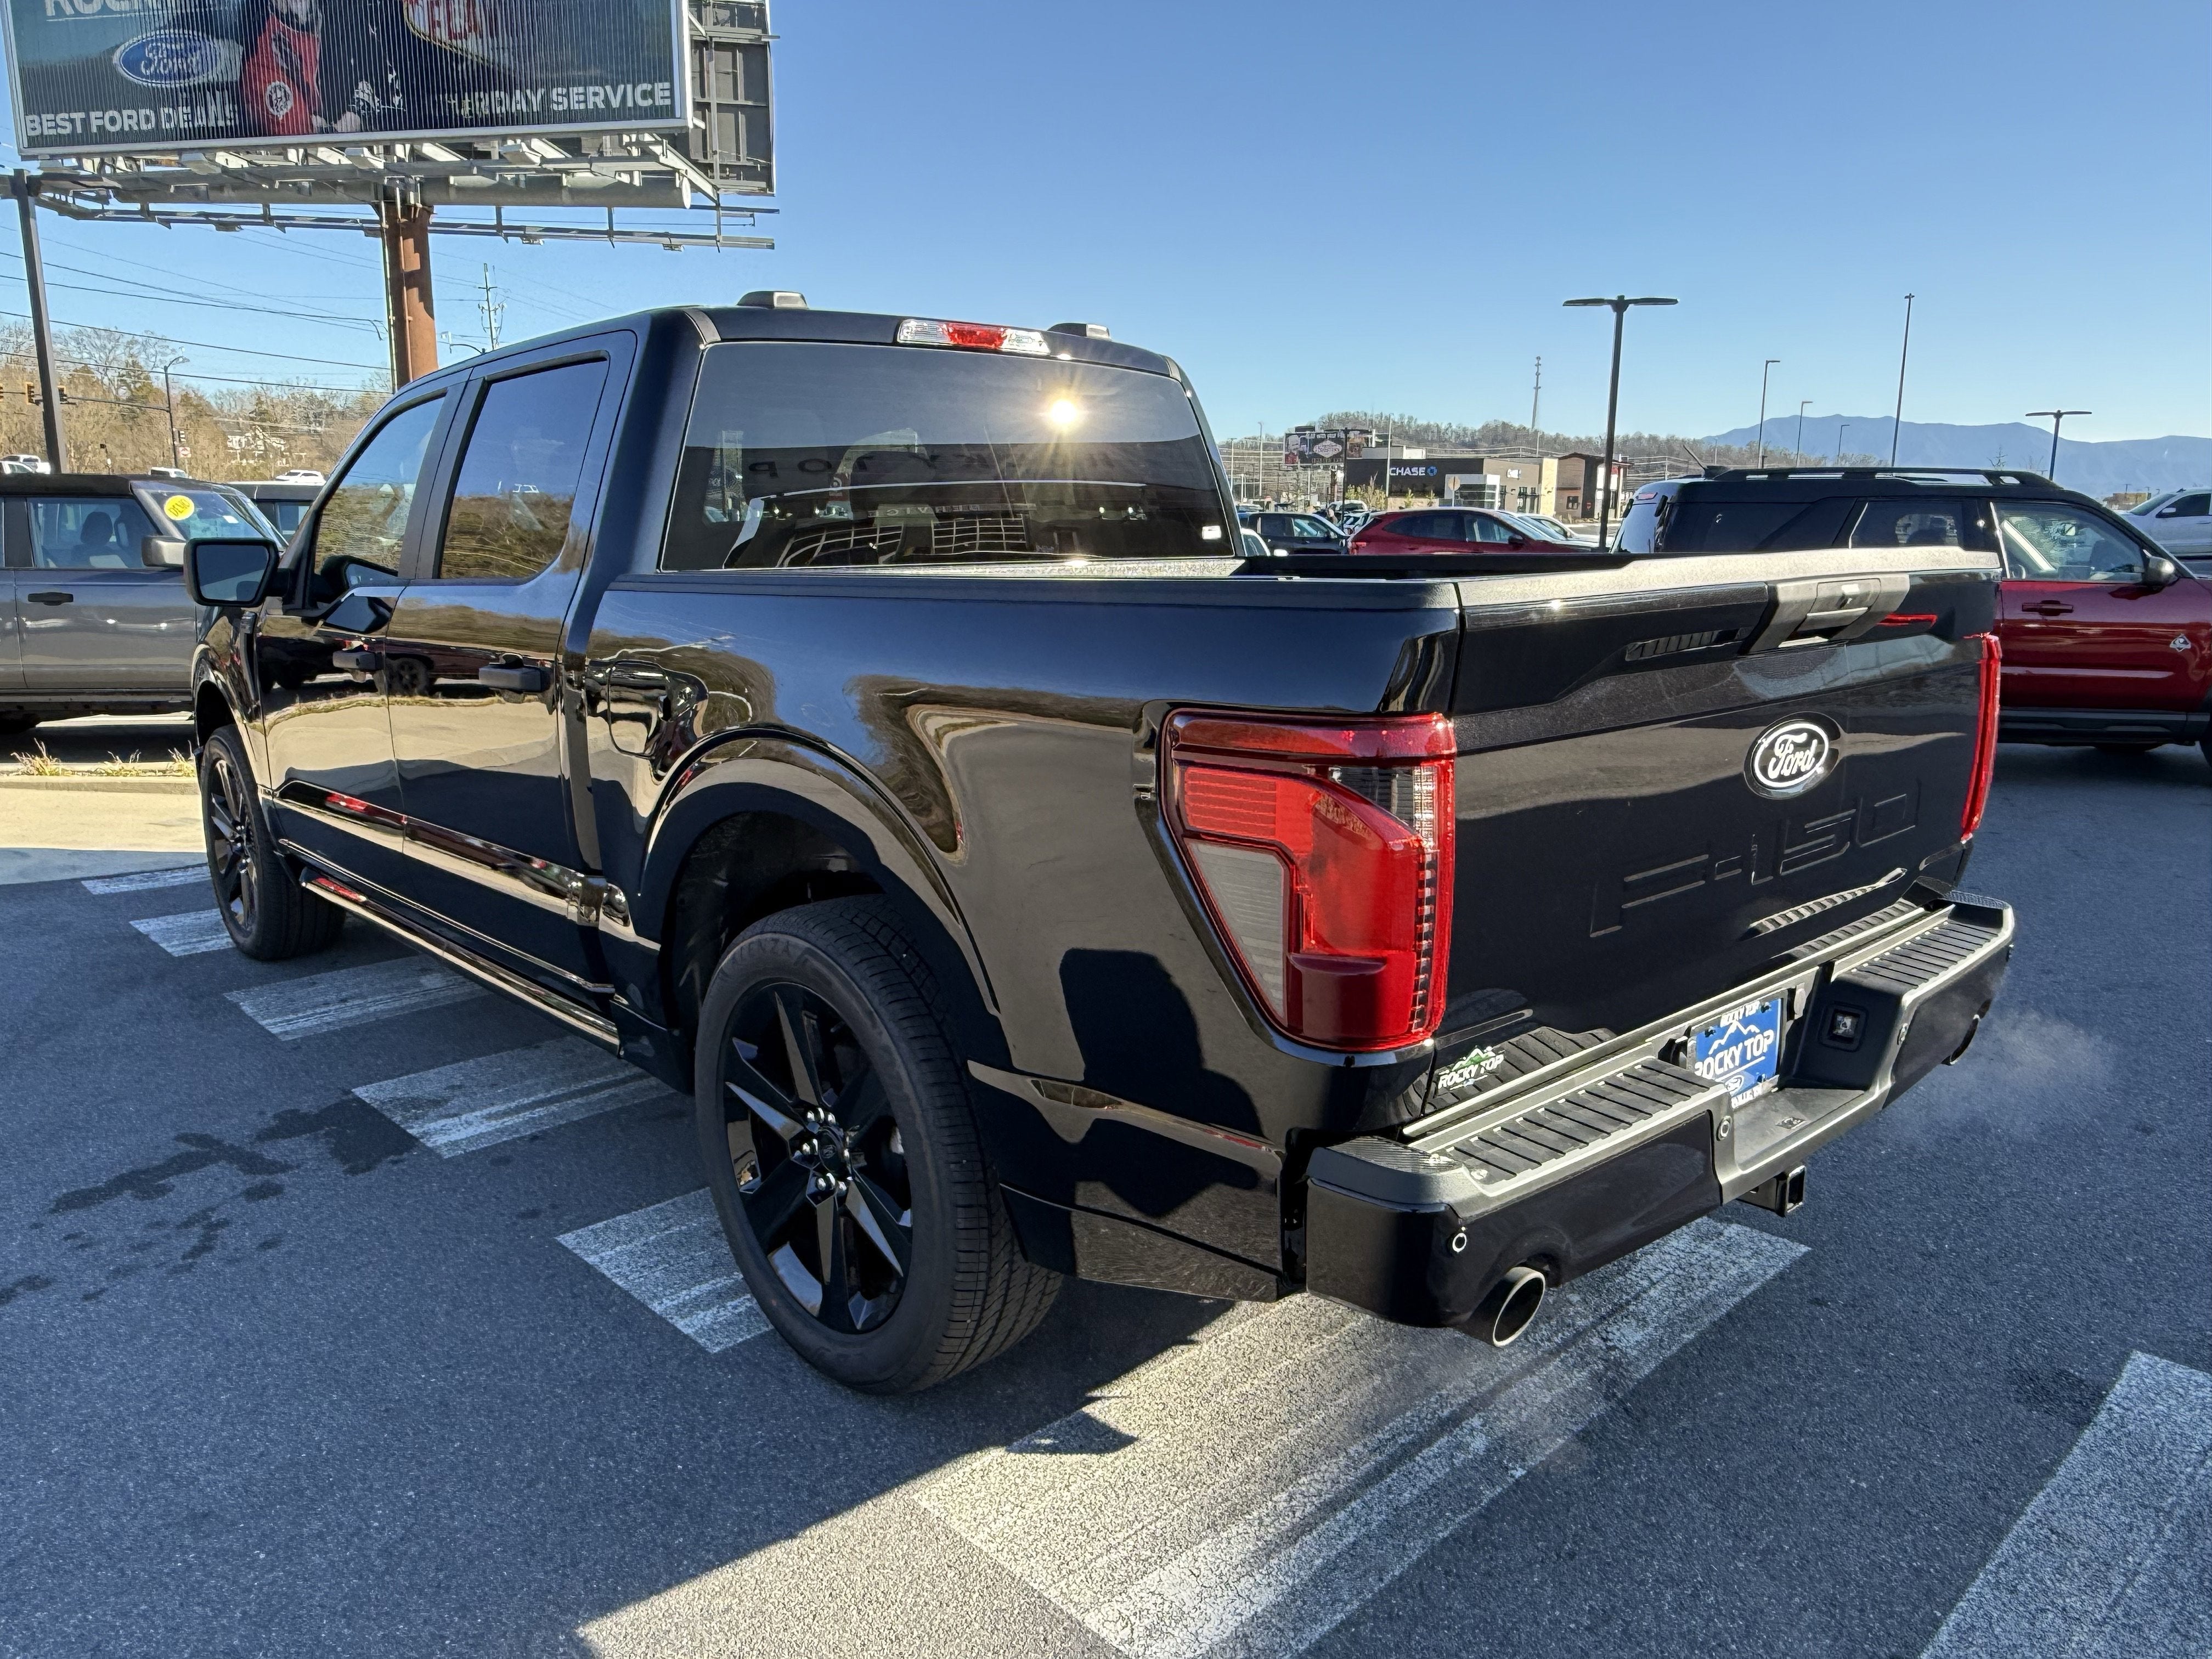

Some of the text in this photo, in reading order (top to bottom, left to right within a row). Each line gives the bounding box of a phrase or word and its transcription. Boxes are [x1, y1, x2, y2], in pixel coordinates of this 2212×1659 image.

[550, 83, 672, 111] SERVICE
[25, 112, 86, 136] BEST
[89, 108, 155, 133] FORD
[1389, 467, 1426, 476] CHASE
[1768, 732, 1818, 779] Ford
[1744, 1029, 1774, 1060] TOP
[1438, 1054, 1504, 1089] ROCKY TOP
